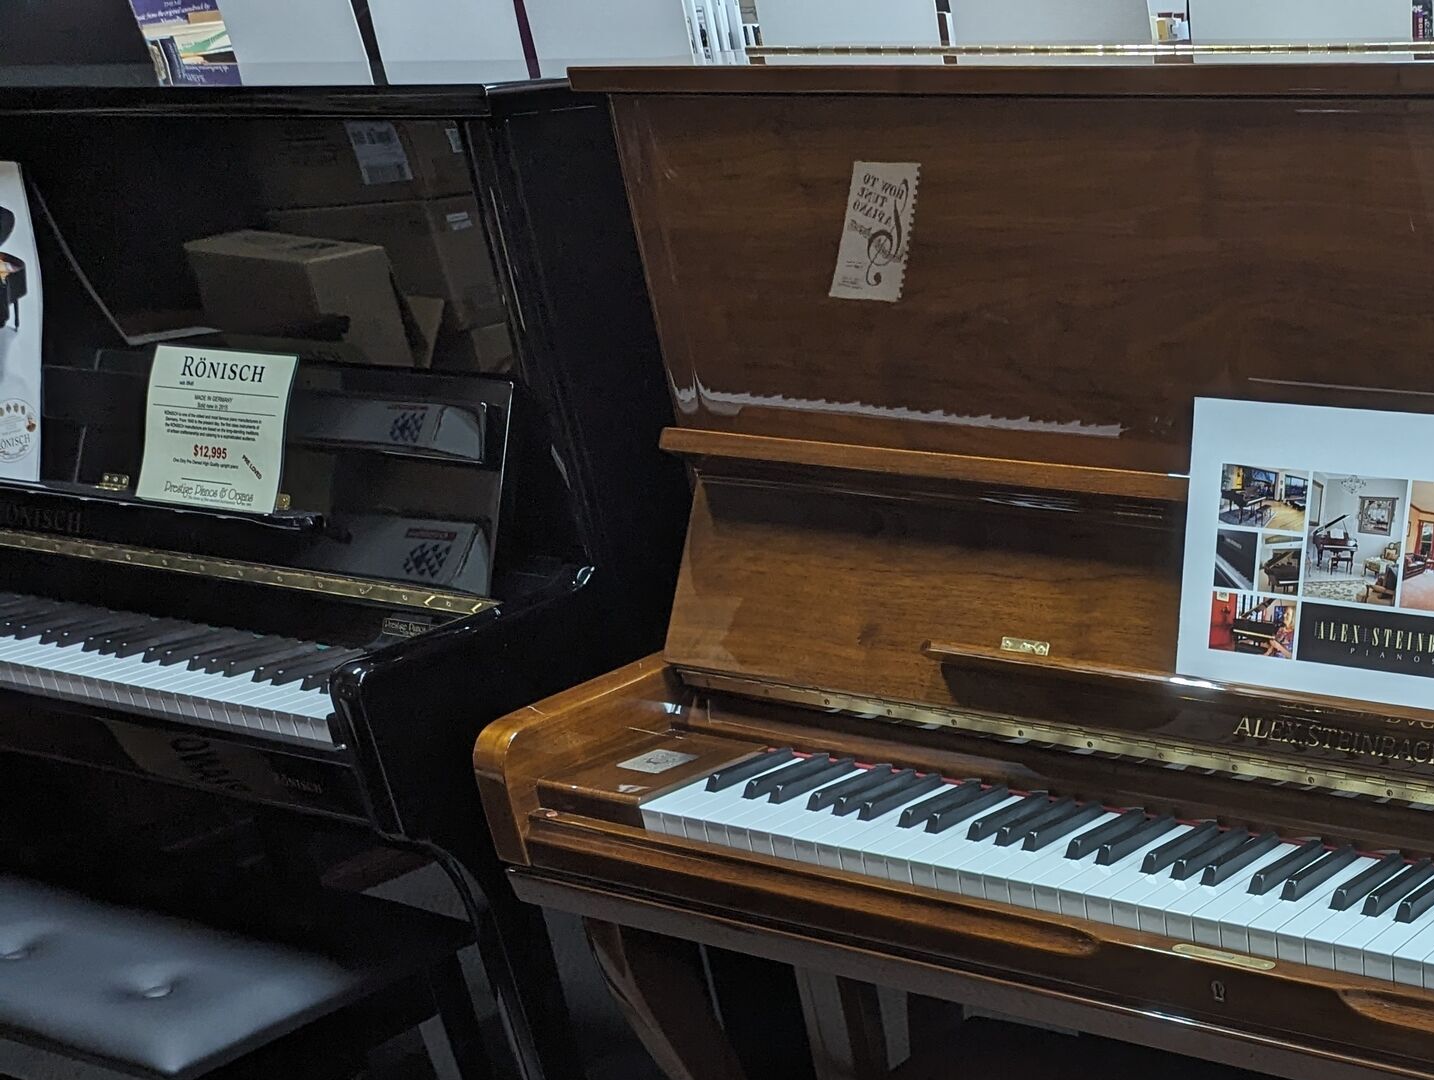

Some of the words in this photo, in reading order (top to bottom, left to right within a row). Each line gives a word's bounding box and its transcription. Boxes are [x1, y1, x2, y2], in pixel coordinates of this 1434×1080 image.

[181, 355, 265, 383] RÖNISCH
[193, 444, 228, 461] $12,995
[1317, 621, 1361, 644] ALEX
